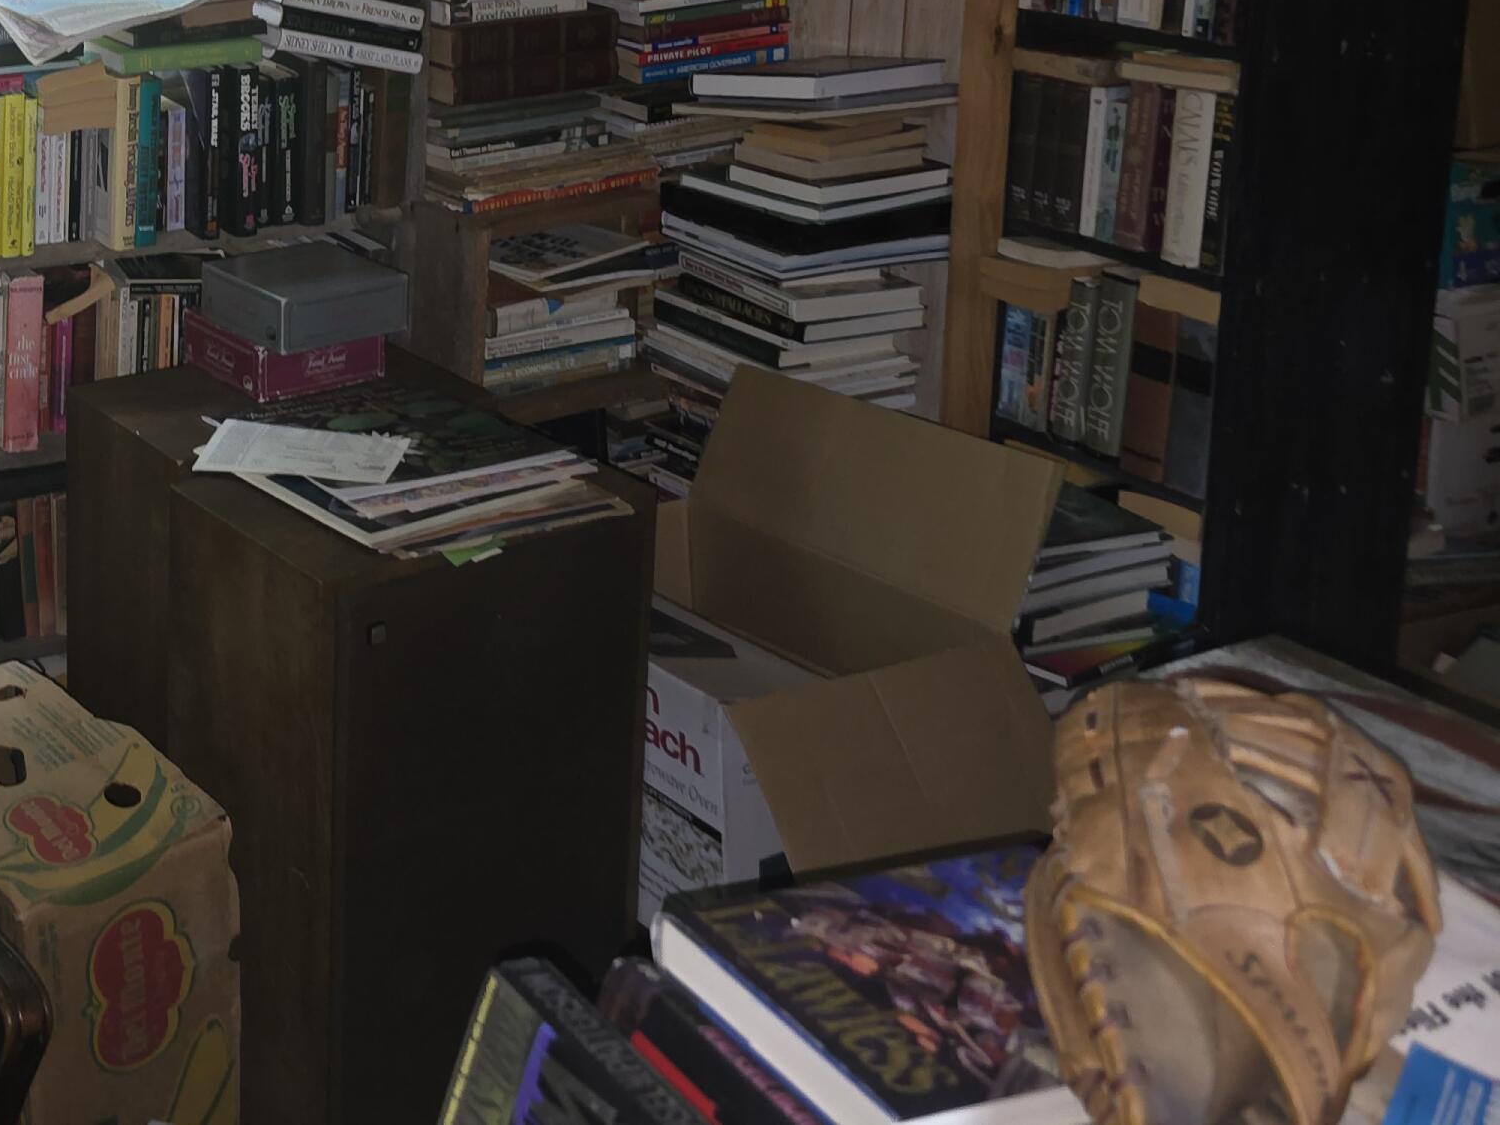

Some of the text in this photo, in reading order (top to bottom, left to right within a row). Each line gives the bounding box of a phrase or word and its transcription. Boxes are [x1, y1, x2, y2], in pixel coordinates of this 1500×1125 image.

[361, 2, 389, 19] FRENCH
[390, 8, 408, 23] SILK
[475, 3, 558, 22] Good Food Gourmet
[284, 34, 310, 52] SIDNEY
[309, 38, 346, 58] SHELDON
[647, 46, 713, 63] PRIVATE PILOT
[676, 55, 751, 74] AMERICAN GOVERNMENT
[126, 83, 138, 111] Jimmy
[240, 73, 250, 132] BROOKS
[250, 86, 259, 130] TERRY
[127, 113, 138, 142] Breslin
[210, 118, 219, 148] WARS
[124, 144, 137, 186] Forsaking
[1066, 300, 1092, 353] TOM
[1095, 297, 1125, 355] TOM
[16, 335, 36, 349] the
[8, 352, 32, 366] first
[8, 366, 38, 380] circle
[644, 720, 704, 777] ach
[687, 782, 719, 819] Oven
